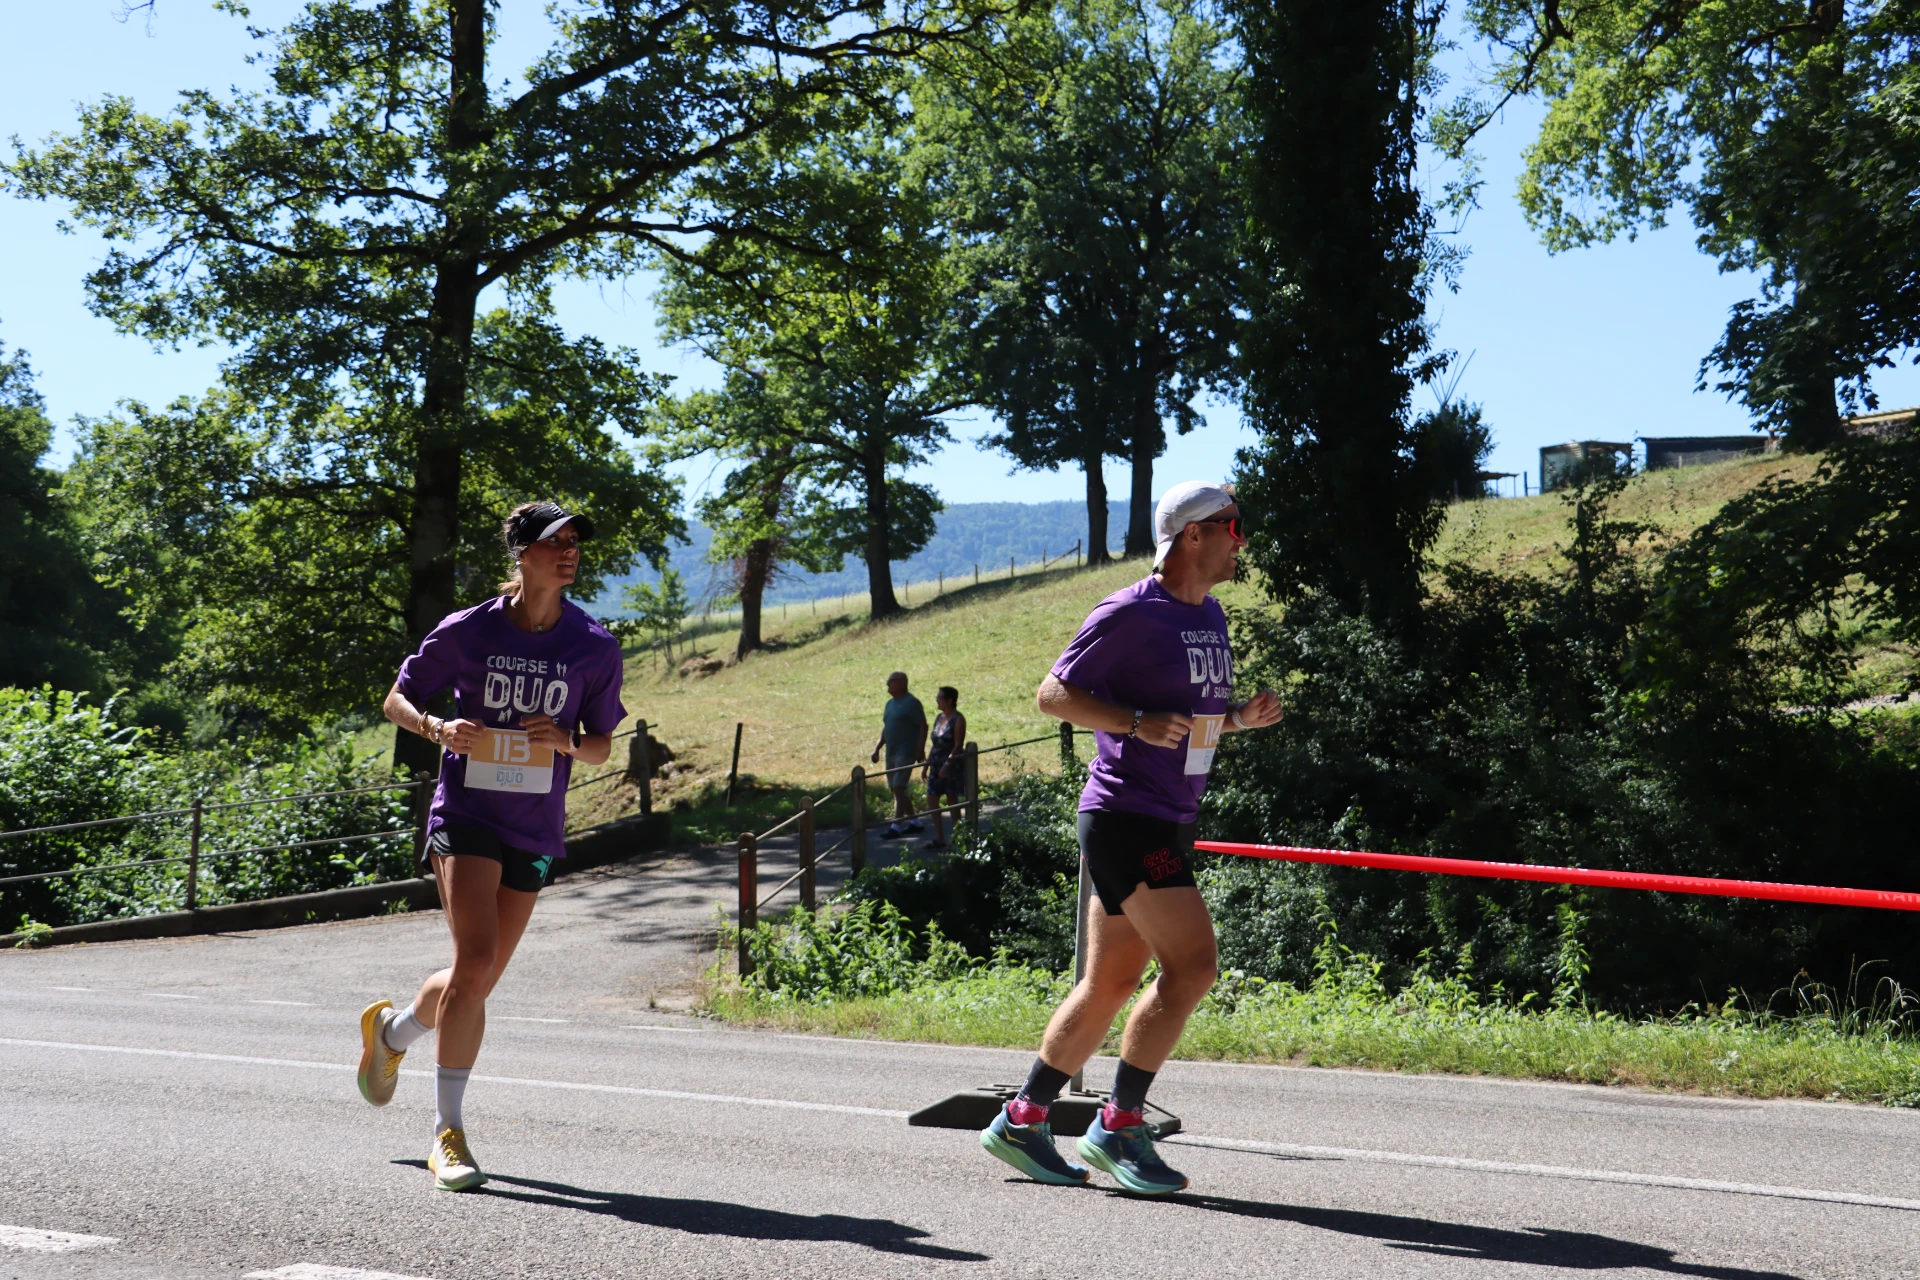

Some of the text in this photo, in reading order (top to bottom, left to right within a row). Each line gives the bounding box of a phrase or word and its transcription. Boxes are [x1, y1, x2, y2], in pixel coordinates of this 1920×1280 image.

[1181, 631, 1220, 643] COURSE
[487, 656, 548, 674] COURSE
[484, 672, 568, 716] DUO
[493, 733, 531, 763] 113
[497, 771, 523, 783] DUO
